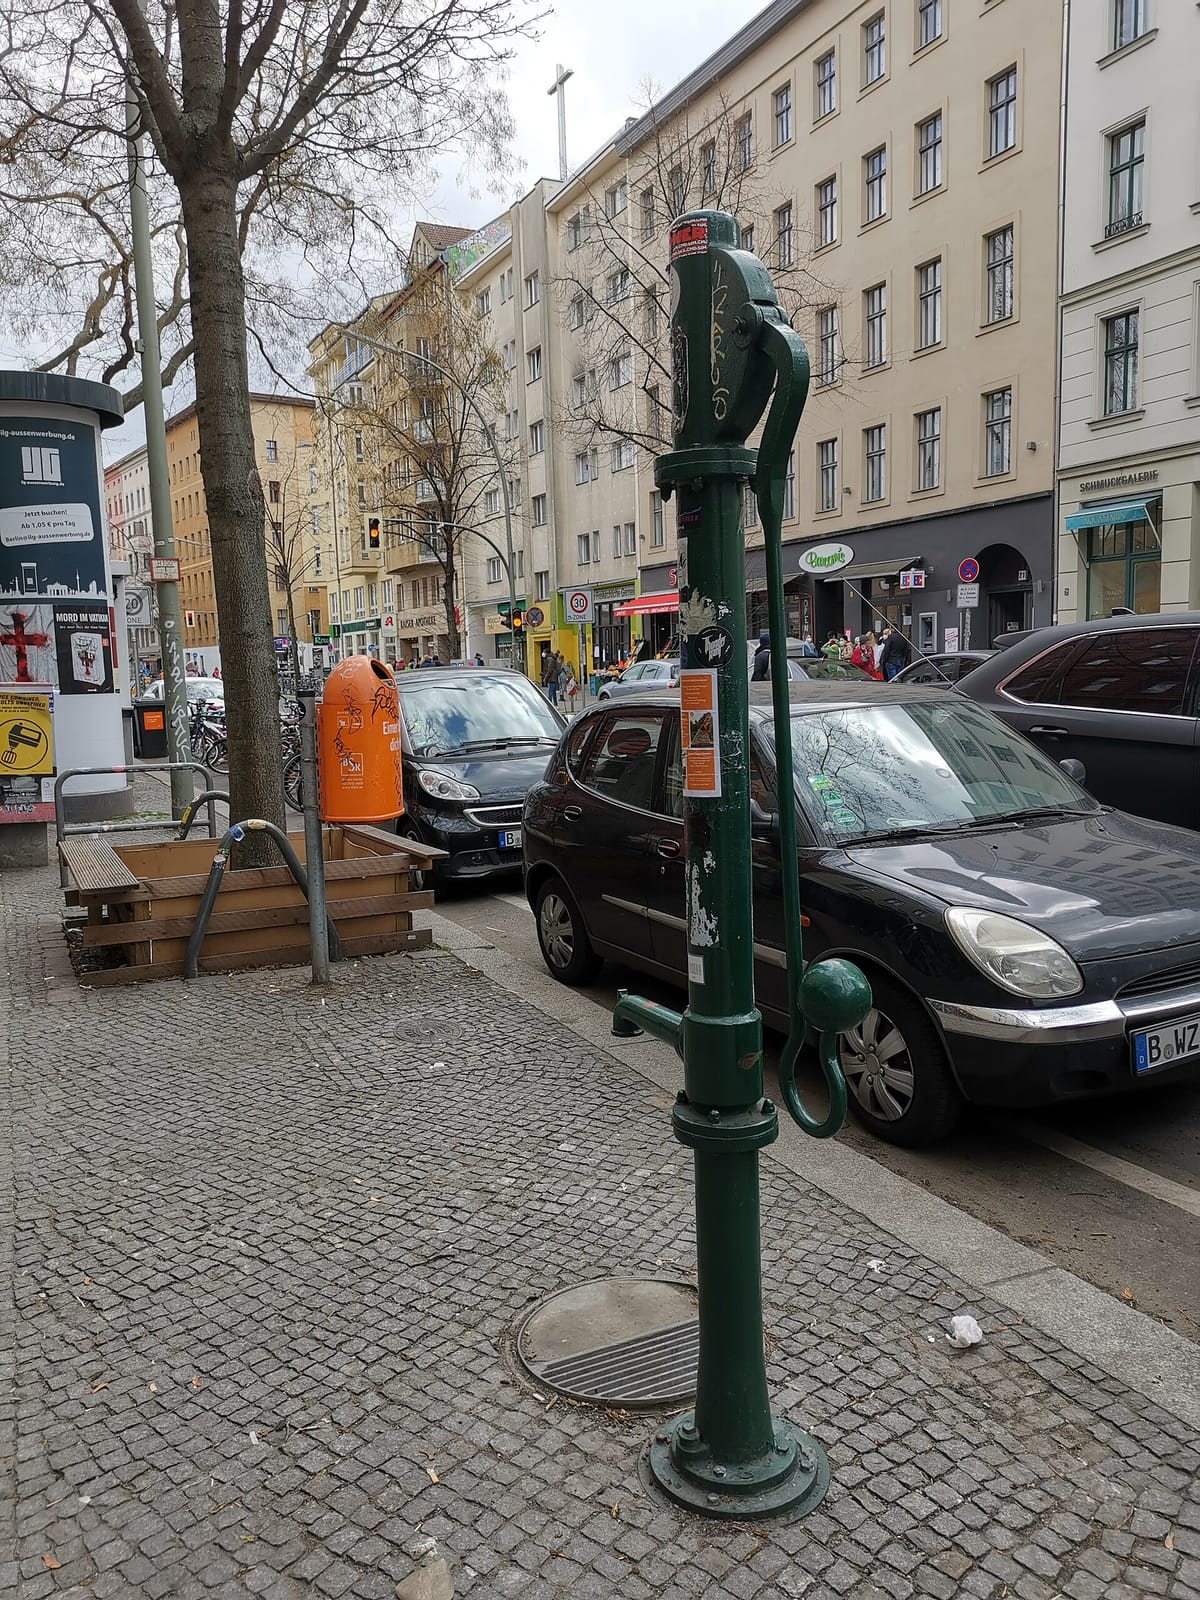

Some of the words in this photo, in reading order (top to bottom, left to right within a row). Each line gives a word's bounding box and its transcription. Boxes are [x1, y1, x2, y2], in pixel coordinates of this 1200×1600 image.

[1080, 471, 1158, 492] SCHMUCKGALERIE
[573, 597, 586, 609] 30
[56, 613, 79, 622] MORD
[80, 613, 88, 622] IM
[506, 832, 515, 846] B
[1148, 1035, 1161, 1063] B
[1174, 1023, 1199, 1055] WZ
